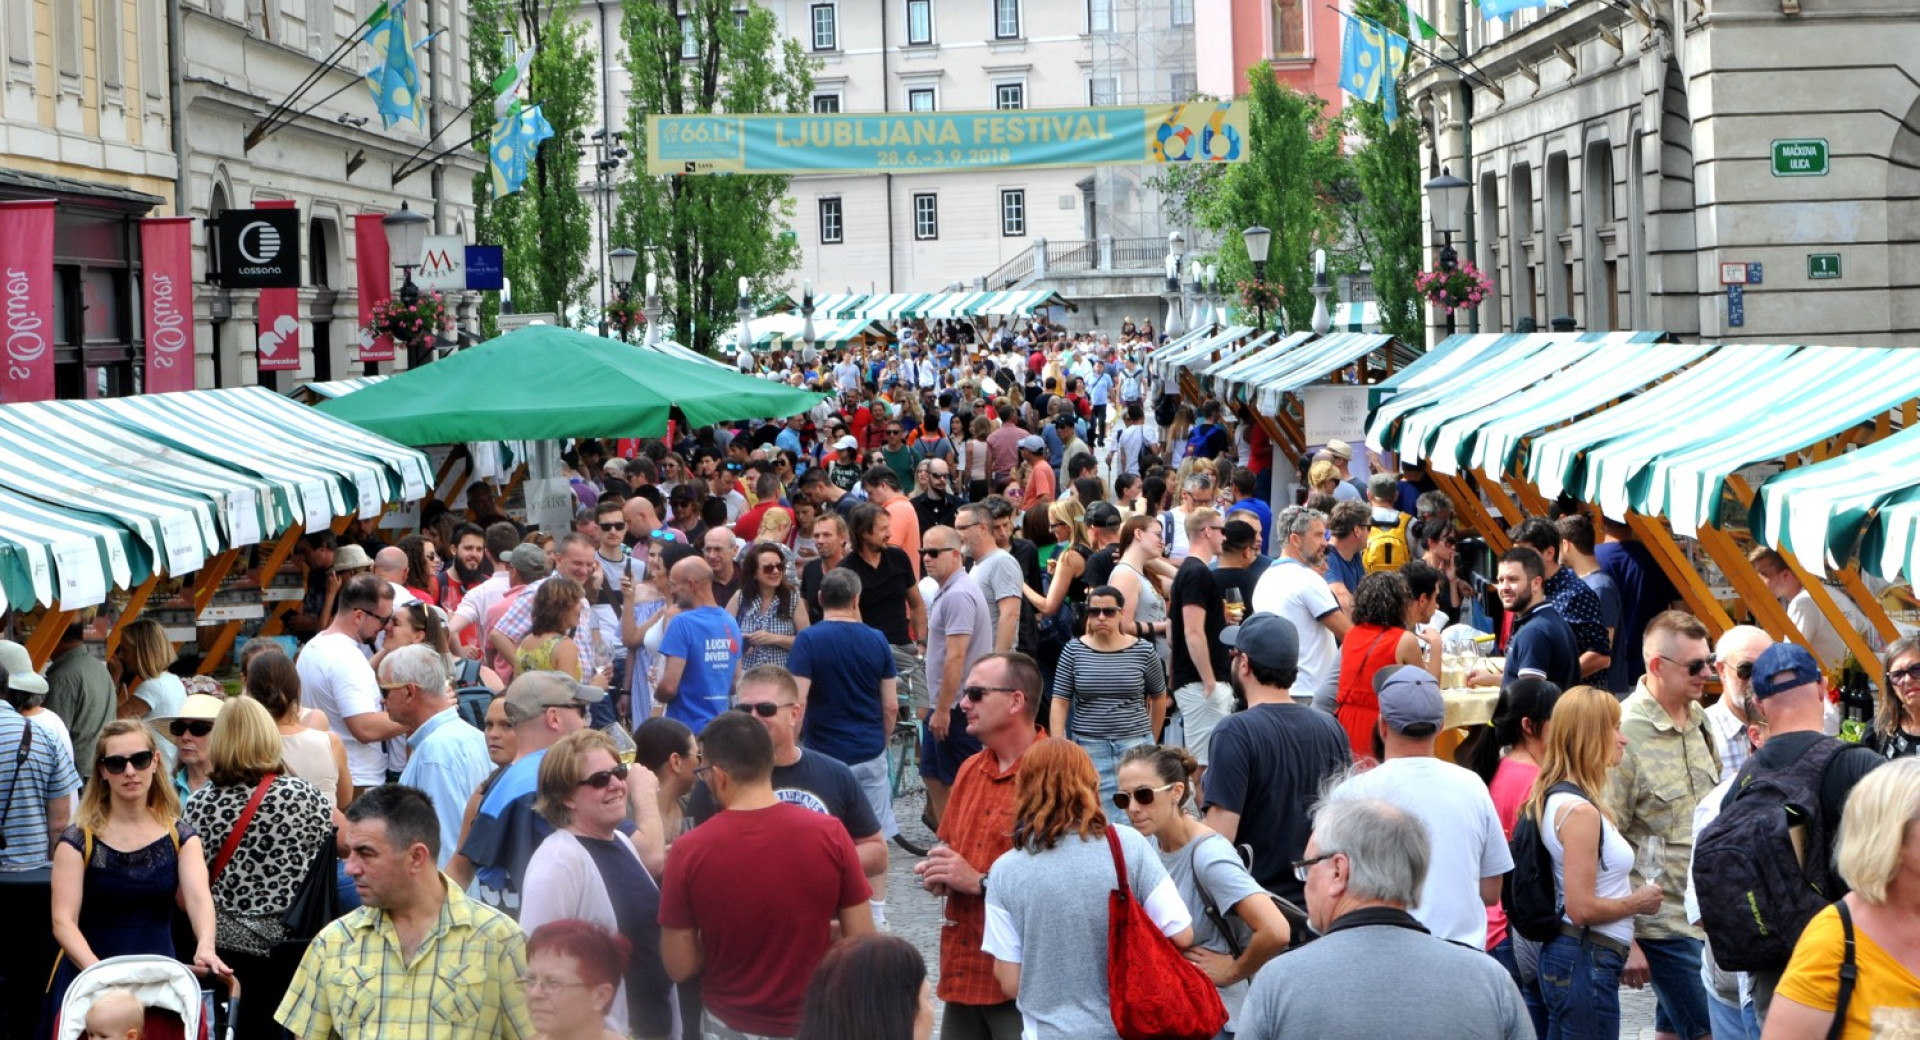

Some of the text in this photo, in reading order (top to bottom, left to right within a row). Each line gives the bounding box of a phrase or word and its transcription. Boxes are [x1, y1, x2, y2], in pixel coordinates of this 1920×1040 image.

[681, 122, 736, 142] 66.LF
[776, 115, 1112, 147] LJUBLJANA FESTIVAL
[1782, 145, 1817, 156] MAČKOVA
[1790, 159, 1810, 169] ULICA
[1820, 258, 1826, 271] 1
[260, 358, 299, 366] Mercator
[705, 639, 732, 650] LUCKY
[704, 651, 730, 662] DIVERS
